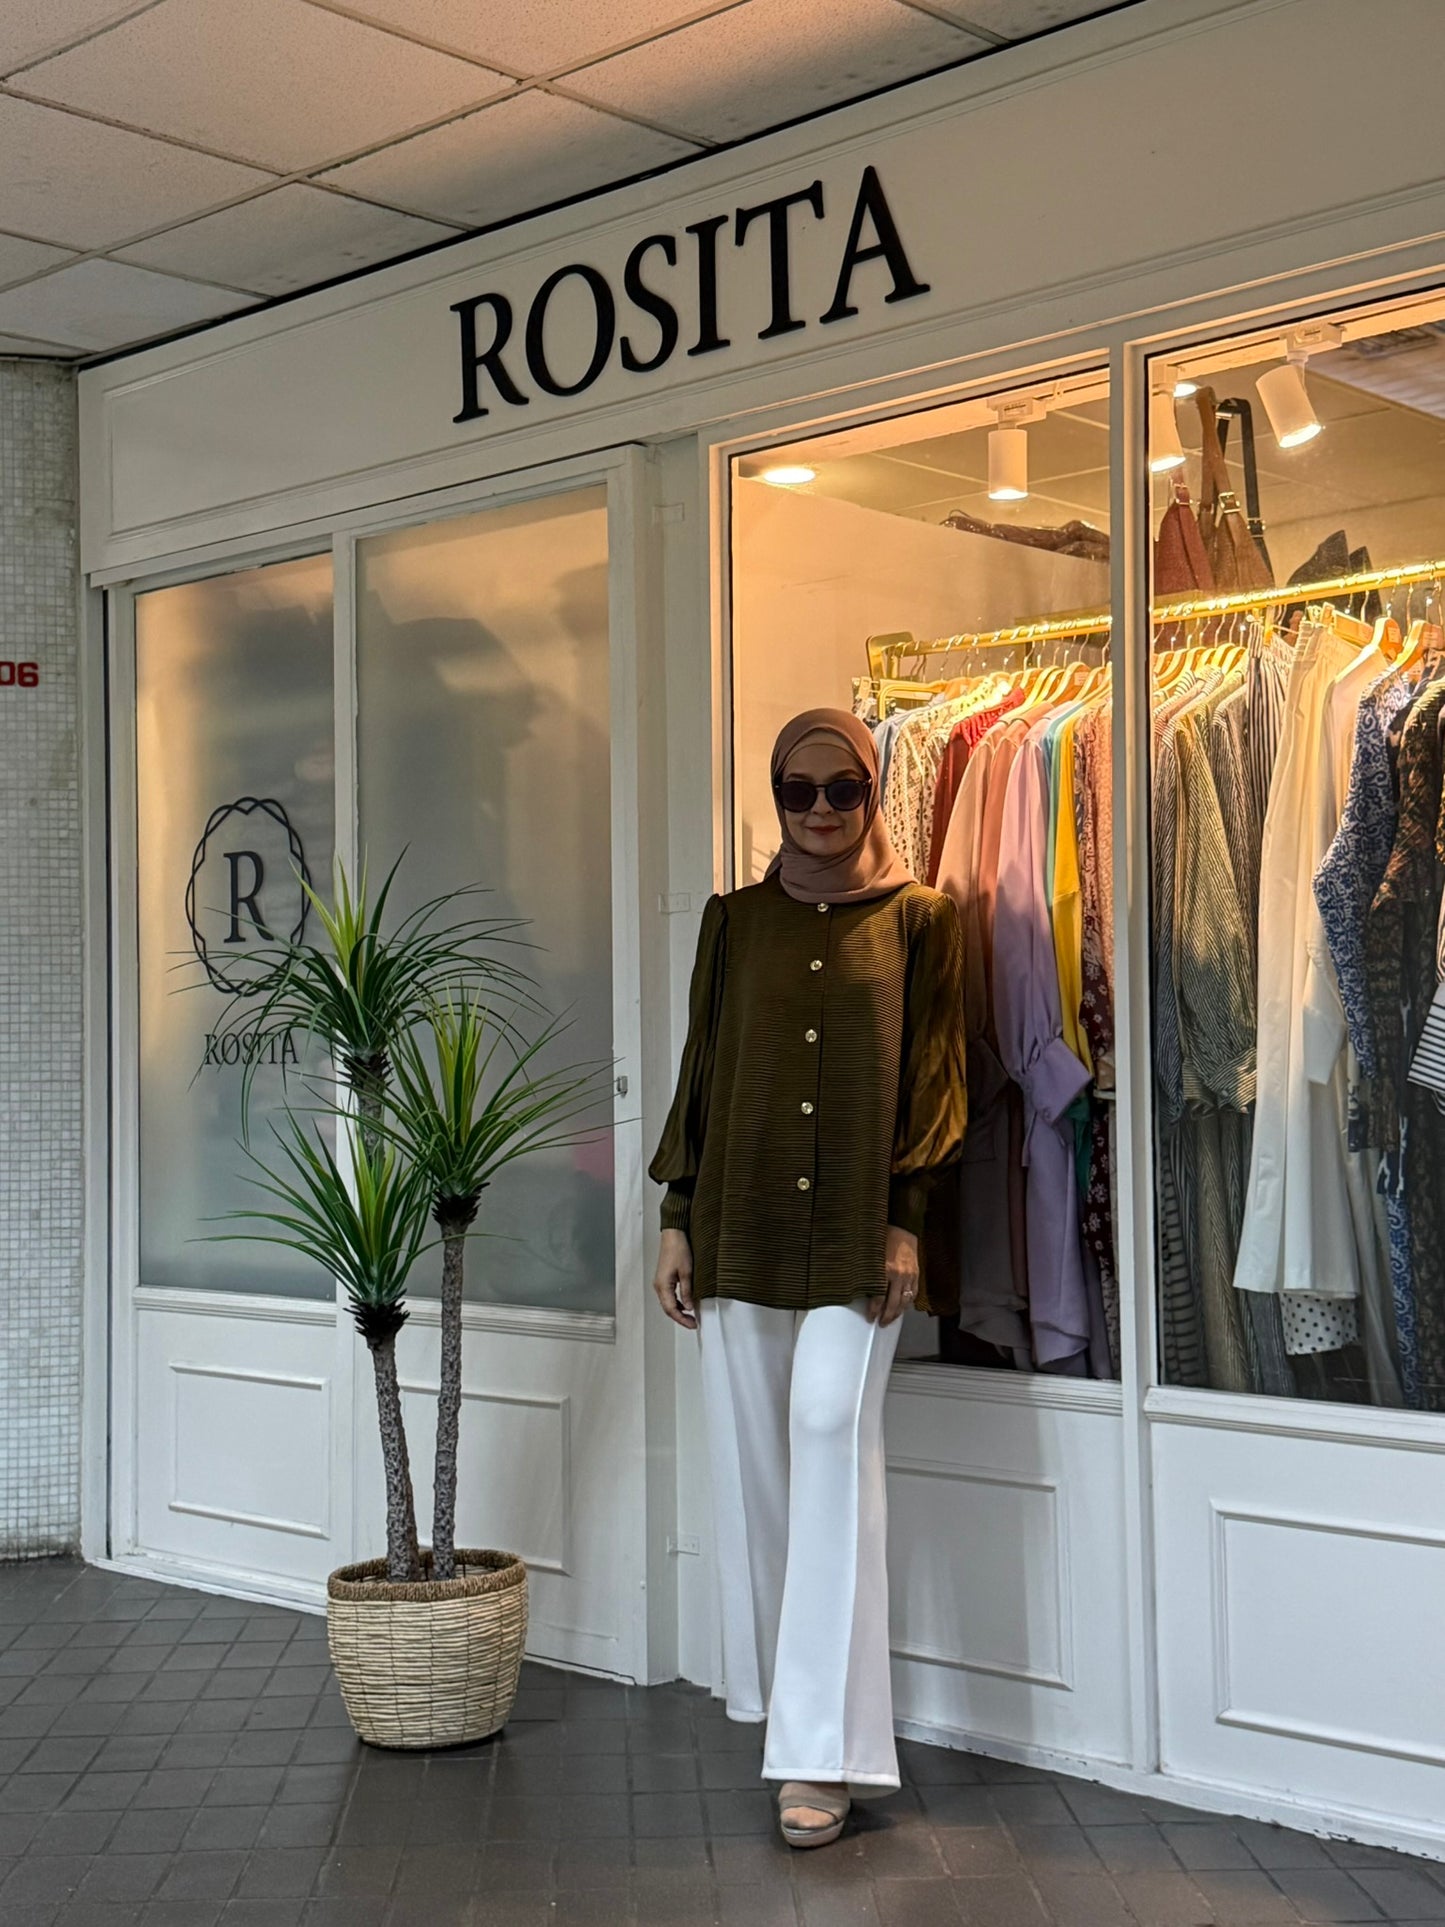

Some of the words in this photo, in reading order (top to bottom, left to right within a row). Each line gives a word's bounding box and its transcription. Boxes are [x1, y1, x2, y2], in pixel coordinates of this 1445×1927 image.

[450, 165, 930, 424] ROSITA
[223, 850, 275, 943] R
[204, 1028, 300, 1066] ROSITA
